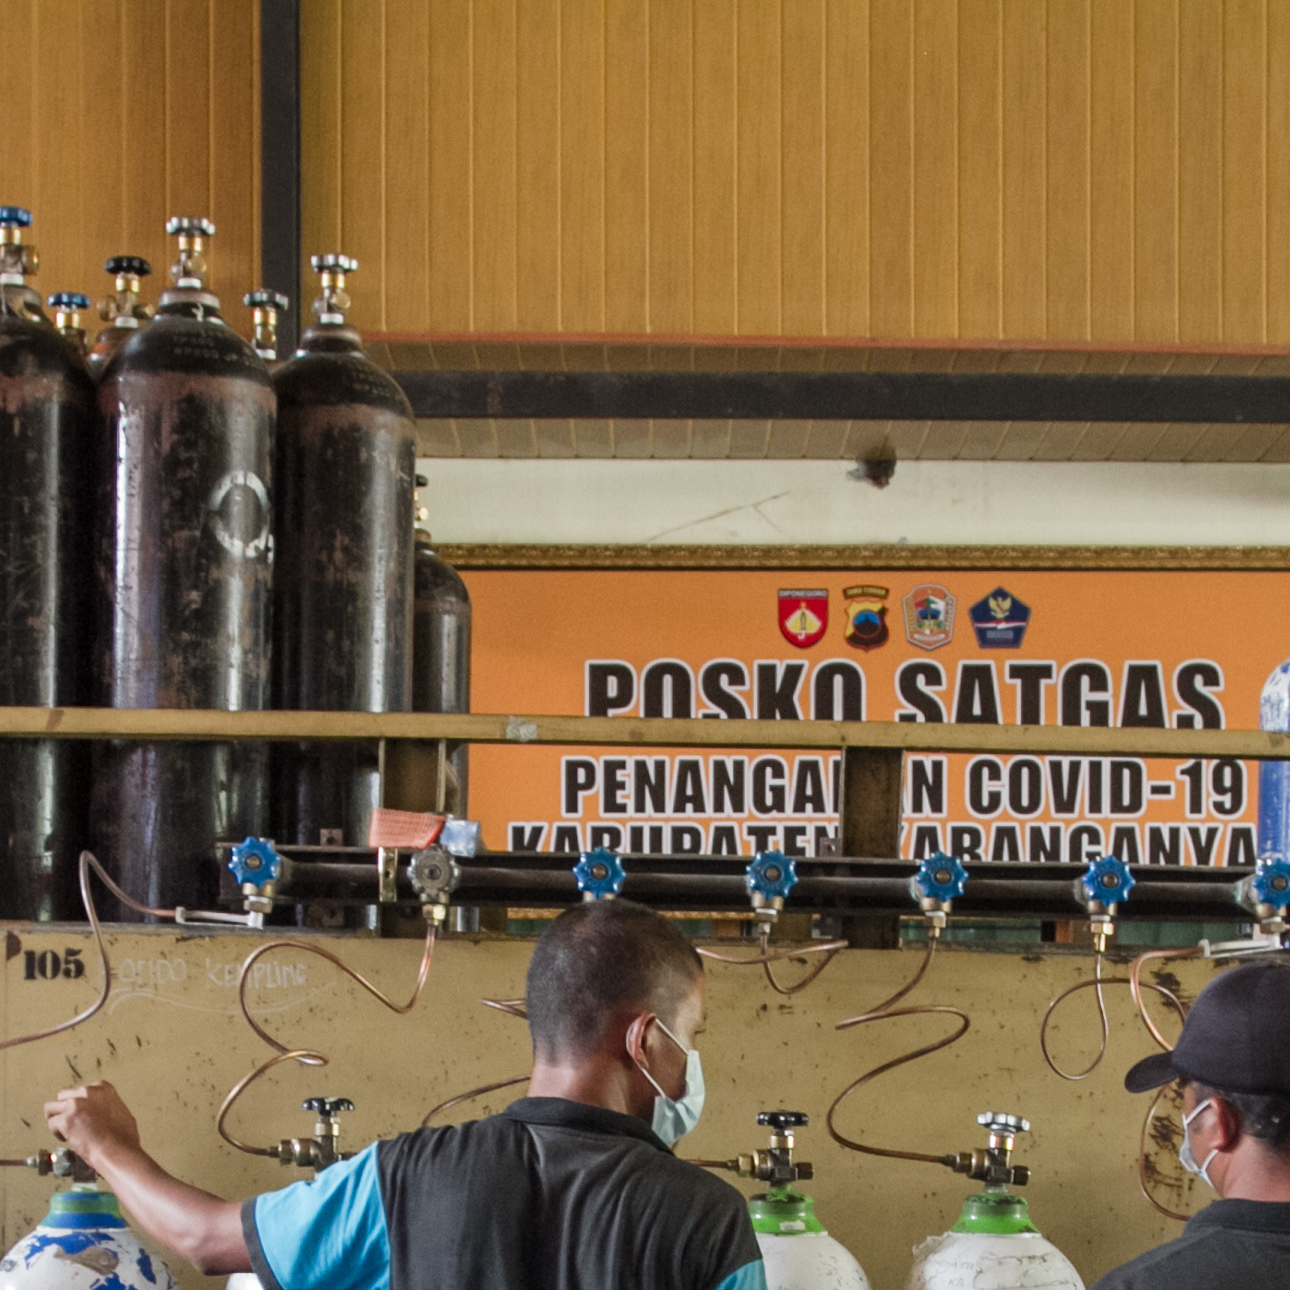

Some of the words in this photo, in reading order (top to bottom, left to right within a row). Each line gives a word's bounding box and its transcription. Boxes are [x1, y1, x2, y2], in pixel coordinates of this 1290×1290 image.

[586, 659, 866, 720] POSKO
[896, 659, 1224, 730] SATGAS
[563, 757, 945, 816] PENANGAN
[967, 757, 1246, 818] COVID-19
[898, 824, 1258, 868] ARANGANYA
[24, 948, 85, 980] 105
